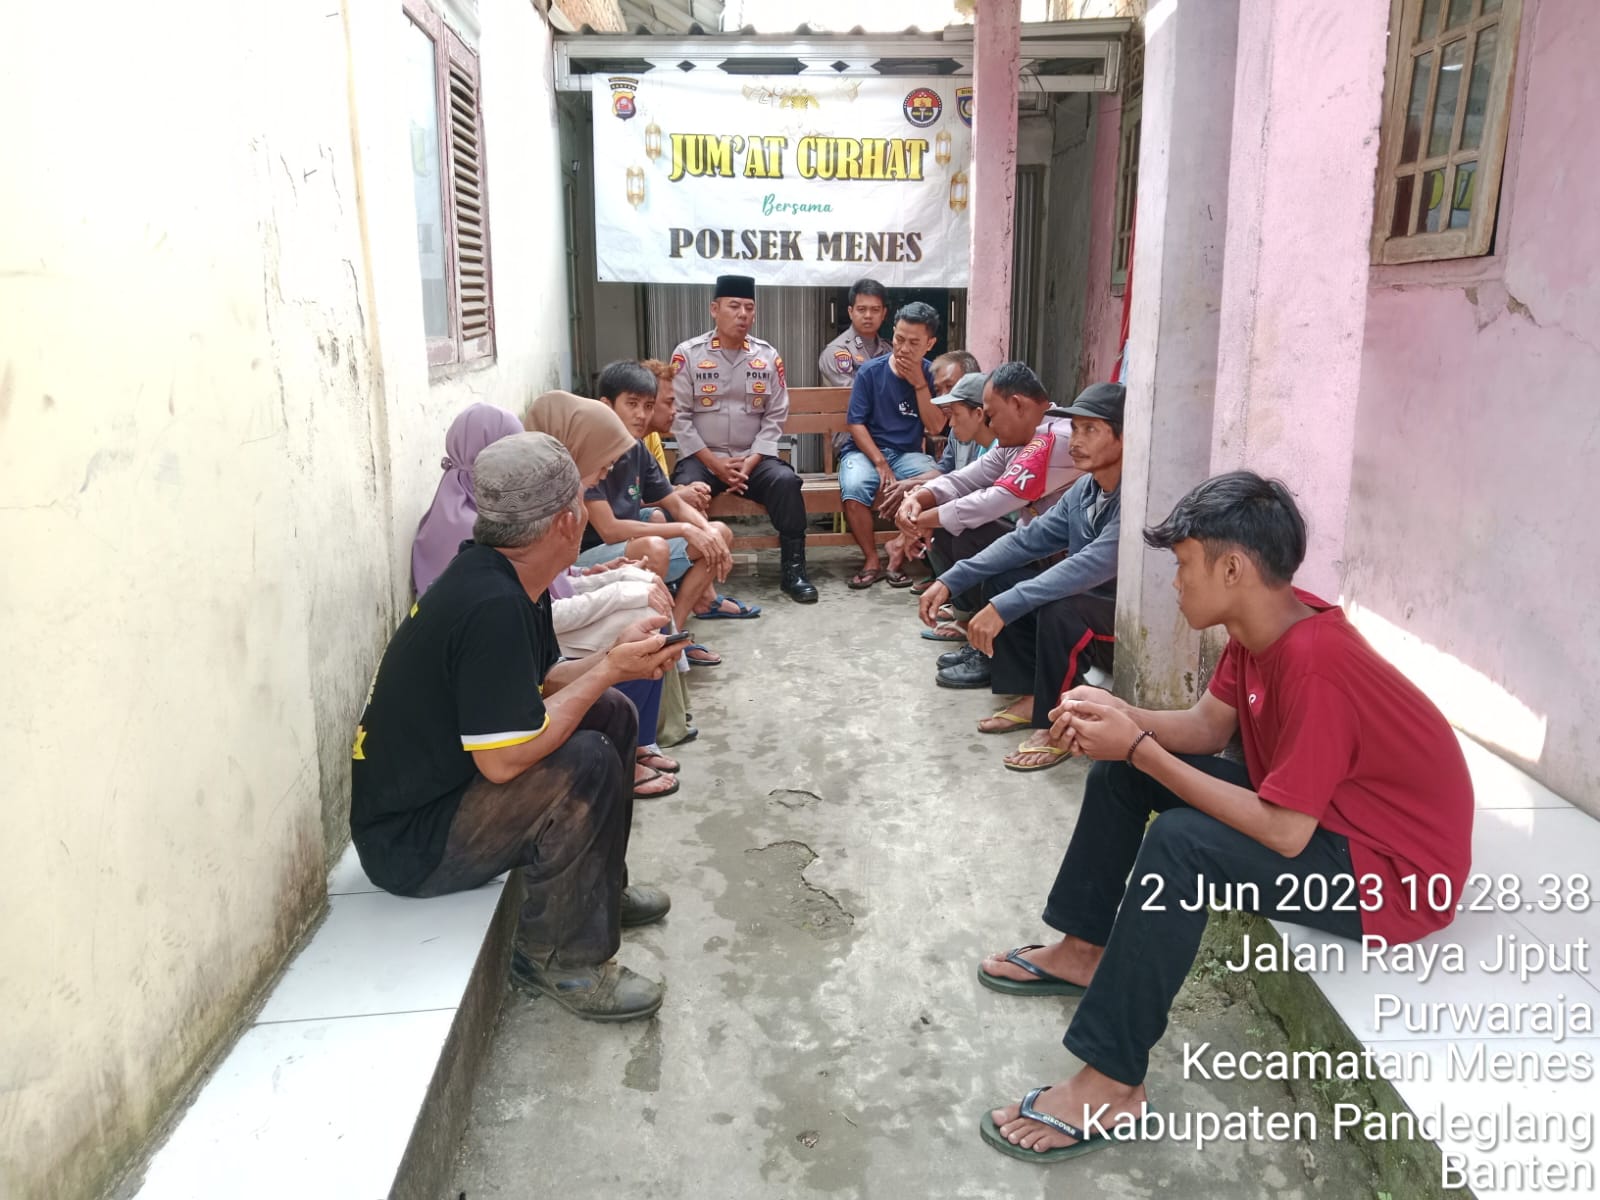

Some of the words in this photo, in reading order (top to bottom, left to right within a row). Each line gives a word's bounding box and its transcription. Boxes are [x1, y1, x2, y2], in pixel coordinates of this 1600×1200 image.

[796, 136, 929, 181] CURHAT
[762, 193, 833, 216] Bersama
[668, 227, 804, 261] POLSEK
[816, 231, 922, 263] MENES
[696, 372, 720, 380] HERO
[746, 371, 770, 380] POLRI
